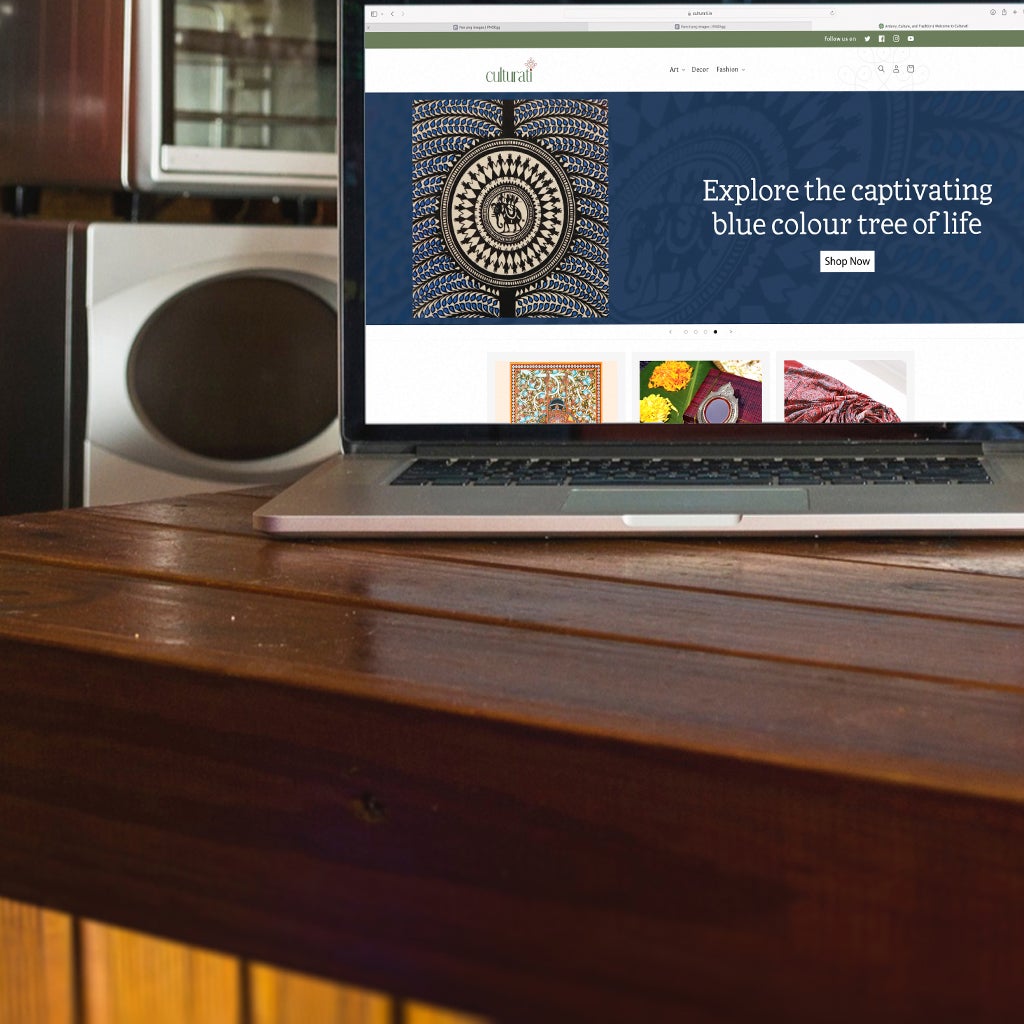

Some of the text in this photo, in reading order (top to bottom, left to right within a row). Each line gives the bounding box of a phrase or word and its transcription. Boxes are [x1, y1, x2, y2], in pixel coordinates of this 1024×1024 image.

[485, 65, 533, 83] culturati
[702, 177, 993, 206] Explore the captivating
[711, 211, 982, 235] blue colour tree of life
[824, 255, 871, 268] Shop Now
